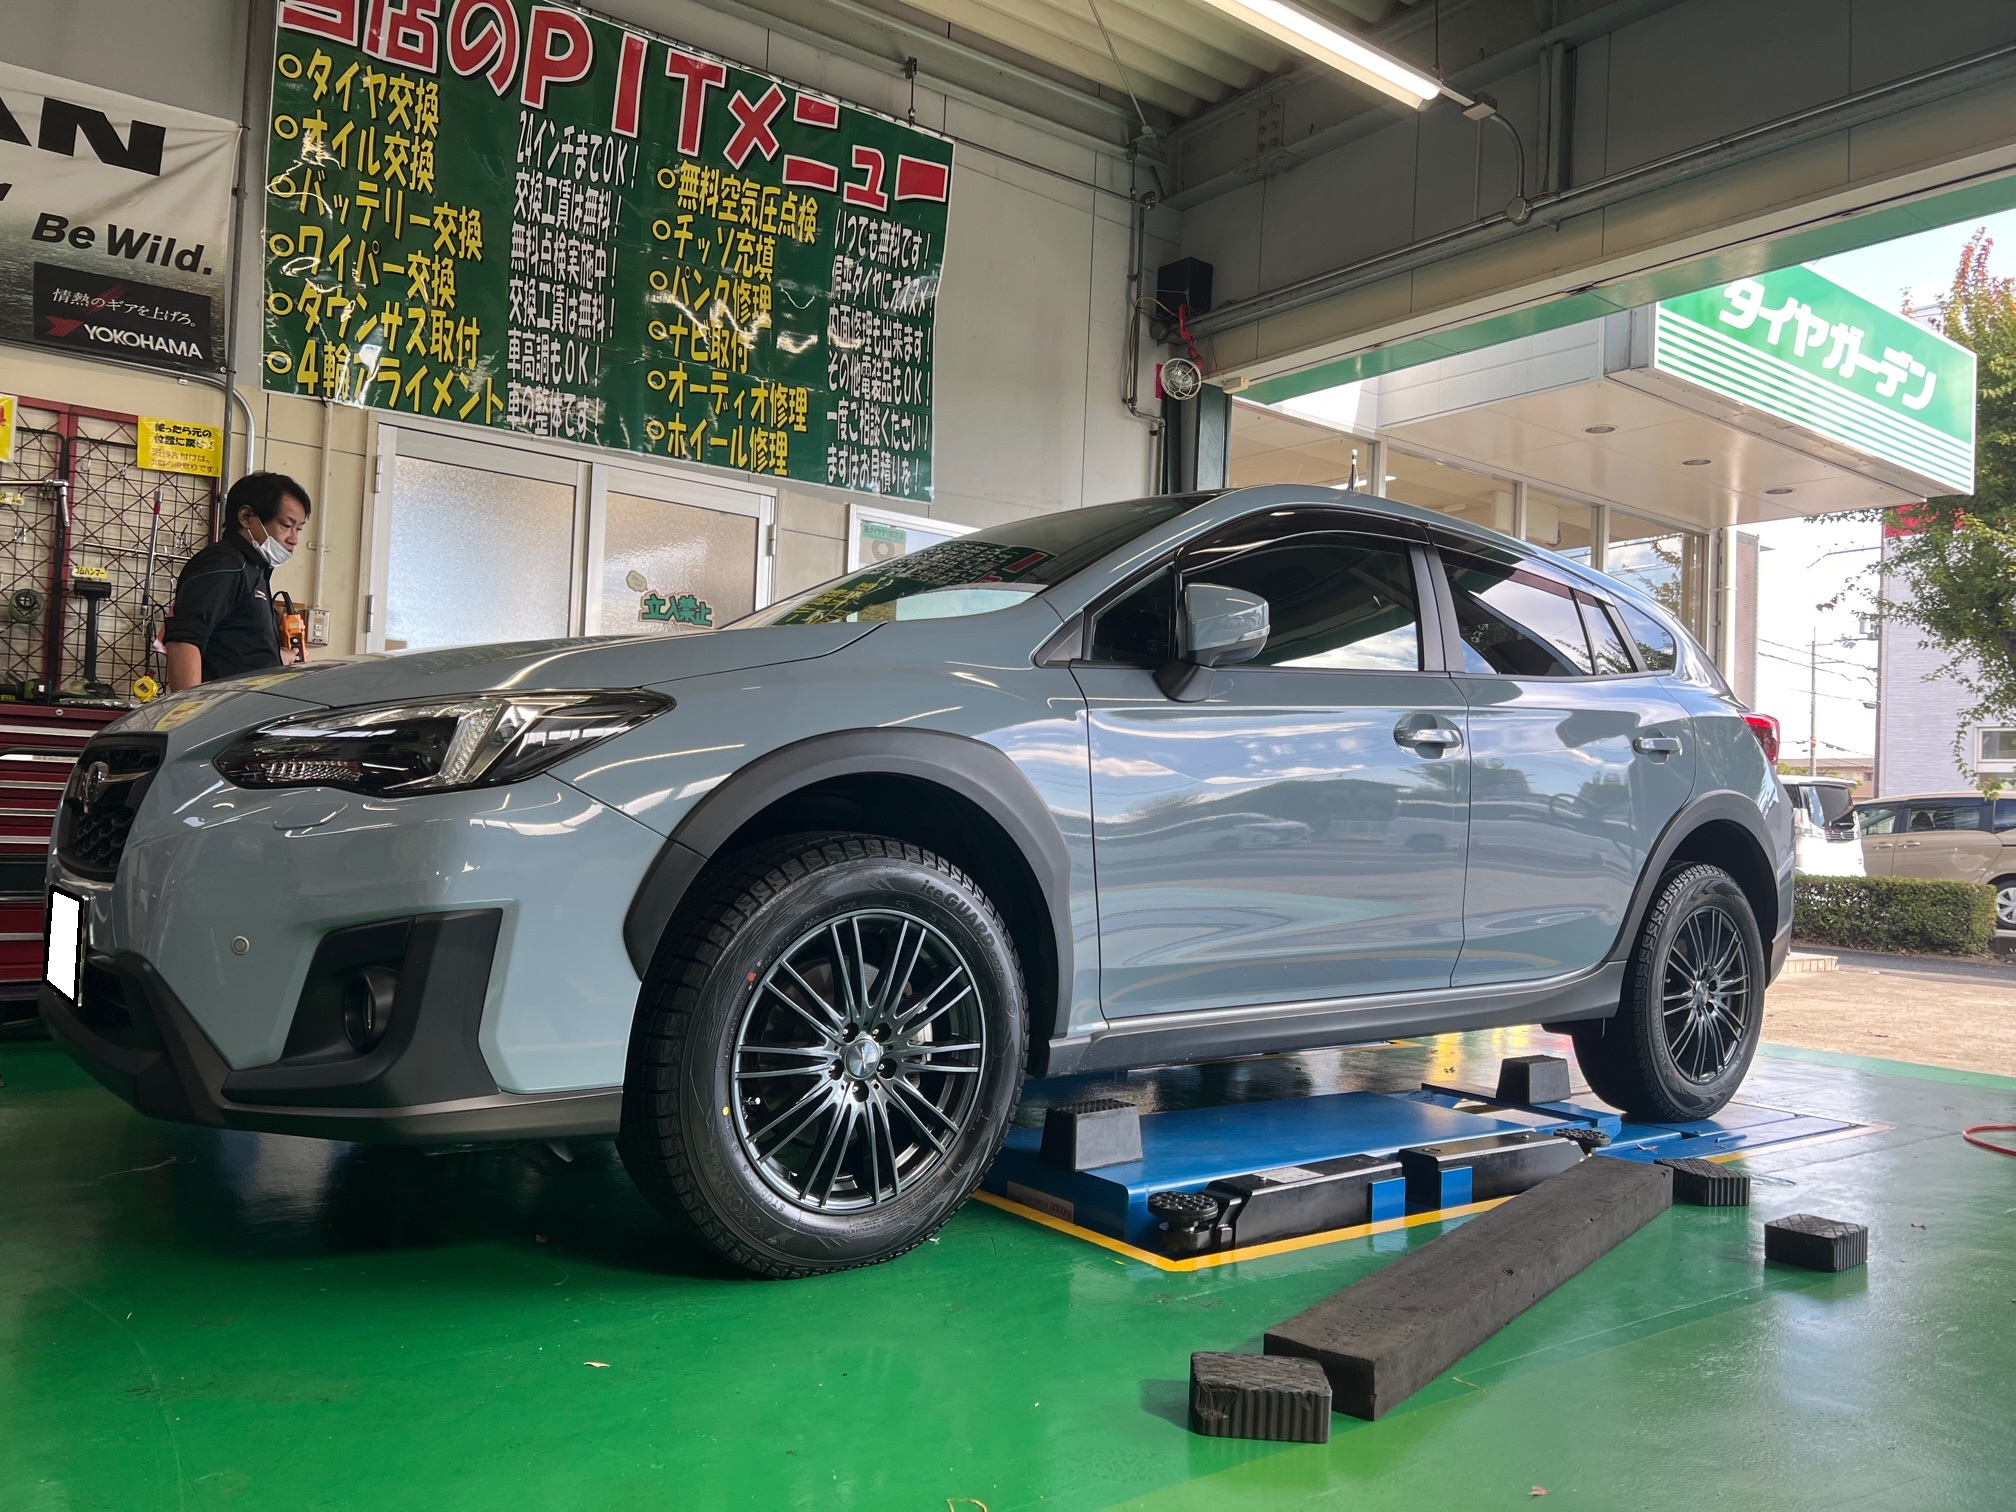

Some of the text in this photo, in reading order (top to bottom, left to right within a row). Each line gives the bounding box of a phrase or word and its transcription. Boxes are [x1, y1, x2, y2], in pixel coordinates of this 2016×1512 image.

[513, 167, 622, 241] 交換工賃は無料！
[31, 212, 213, 276] Be Wild.
[510, 220, 617, 292] 無料点検実施中！
[834, 208, 931, 271] いつでも無料です！
[52, 287, 197, 328] 情熱のギアを上げろ。
[508, 273, 615, 343] 交換工賃は無料！
[83, 323, 203, 360] YOKOHAMA
[506, 326, 600, 387] 車高調もOK！
[1718, 278, 1937, 411] タイヤガーデン
[827, 350, 931, 406] その他電装品もOK！
[826, 396, 929, 452] 一度ご相談ください！
[826, 442, 920, 496] まずはお見積りを！
[641, 593, 713, 628] 立入禁止
[919, 879, 996, 949] iceGUARD
